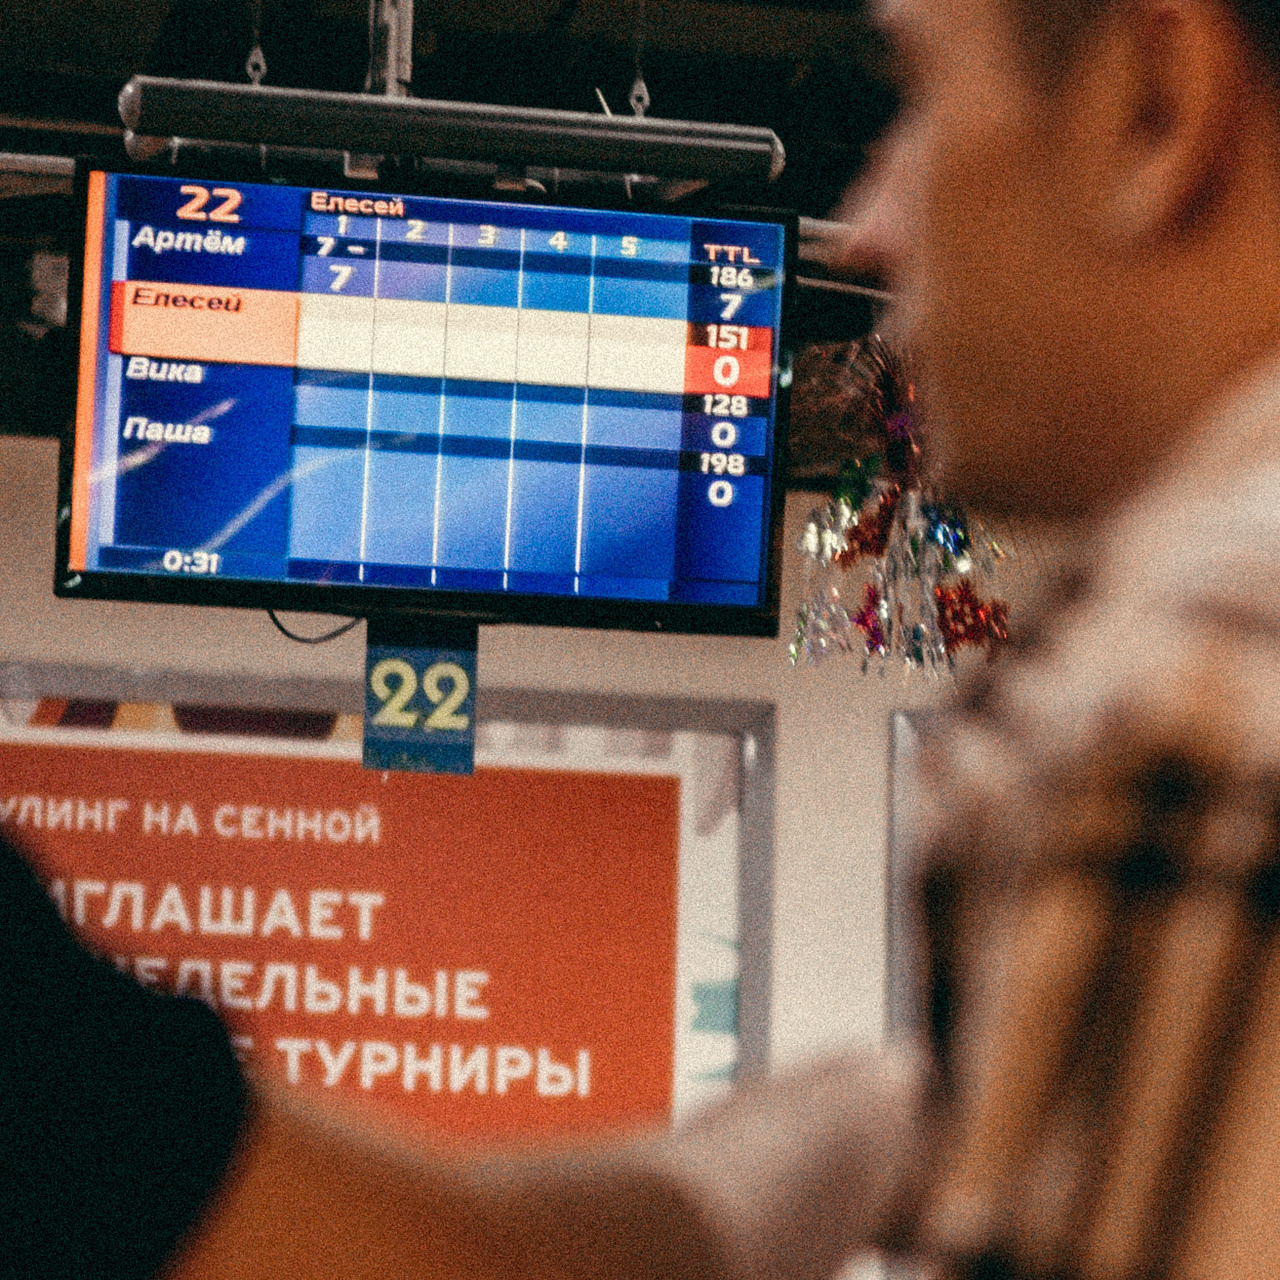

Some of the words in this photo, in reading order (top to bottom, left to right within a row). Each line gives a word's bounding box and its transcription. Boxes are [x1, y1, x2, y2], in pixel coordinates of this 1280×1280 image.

[175, 184, 244, 223] 22
[310, 192, 405, 218] Елесей
[132, 224, 246, 255] Артём
[317, 236, 336, 257] 7
[337, 215, 348, 235] 1
[406, 220, 425, 241] 2
[478, 225, 497, 246] 3
[549, 231, 568, 251] 4
[621, 236, 638, 257] 5
[703, 244, 760, 264] TTL
[330, 265, 353, 291] 7
[710, 266, 753, 287] 186
[132, 287, 243, 312] Елесей
[719, 293, 742, 319] 7
[707, 325, 748, 350] 151
[126, 357, 204, 383] Вика
[713, 356, 739, 387] 0
[704, 394, 747, 416] 128
[123, 416, 211, 444] Паша
[711, 422, 736, 447] 0
[700, 453, 745, 474] 198
[708, 480, 733, 506] 0
[163, 551, 218, 574] 0:31
[370, 657, 470, 731] 22
[142, 801, 201, 836] НА
[214, 802, 382, 843] СЕННОЙ
[115, 955, 491, 1020] ЕДЕЛЬНЫЕ
[274, 1036, 591, 1099] ТУРНИРЫ
